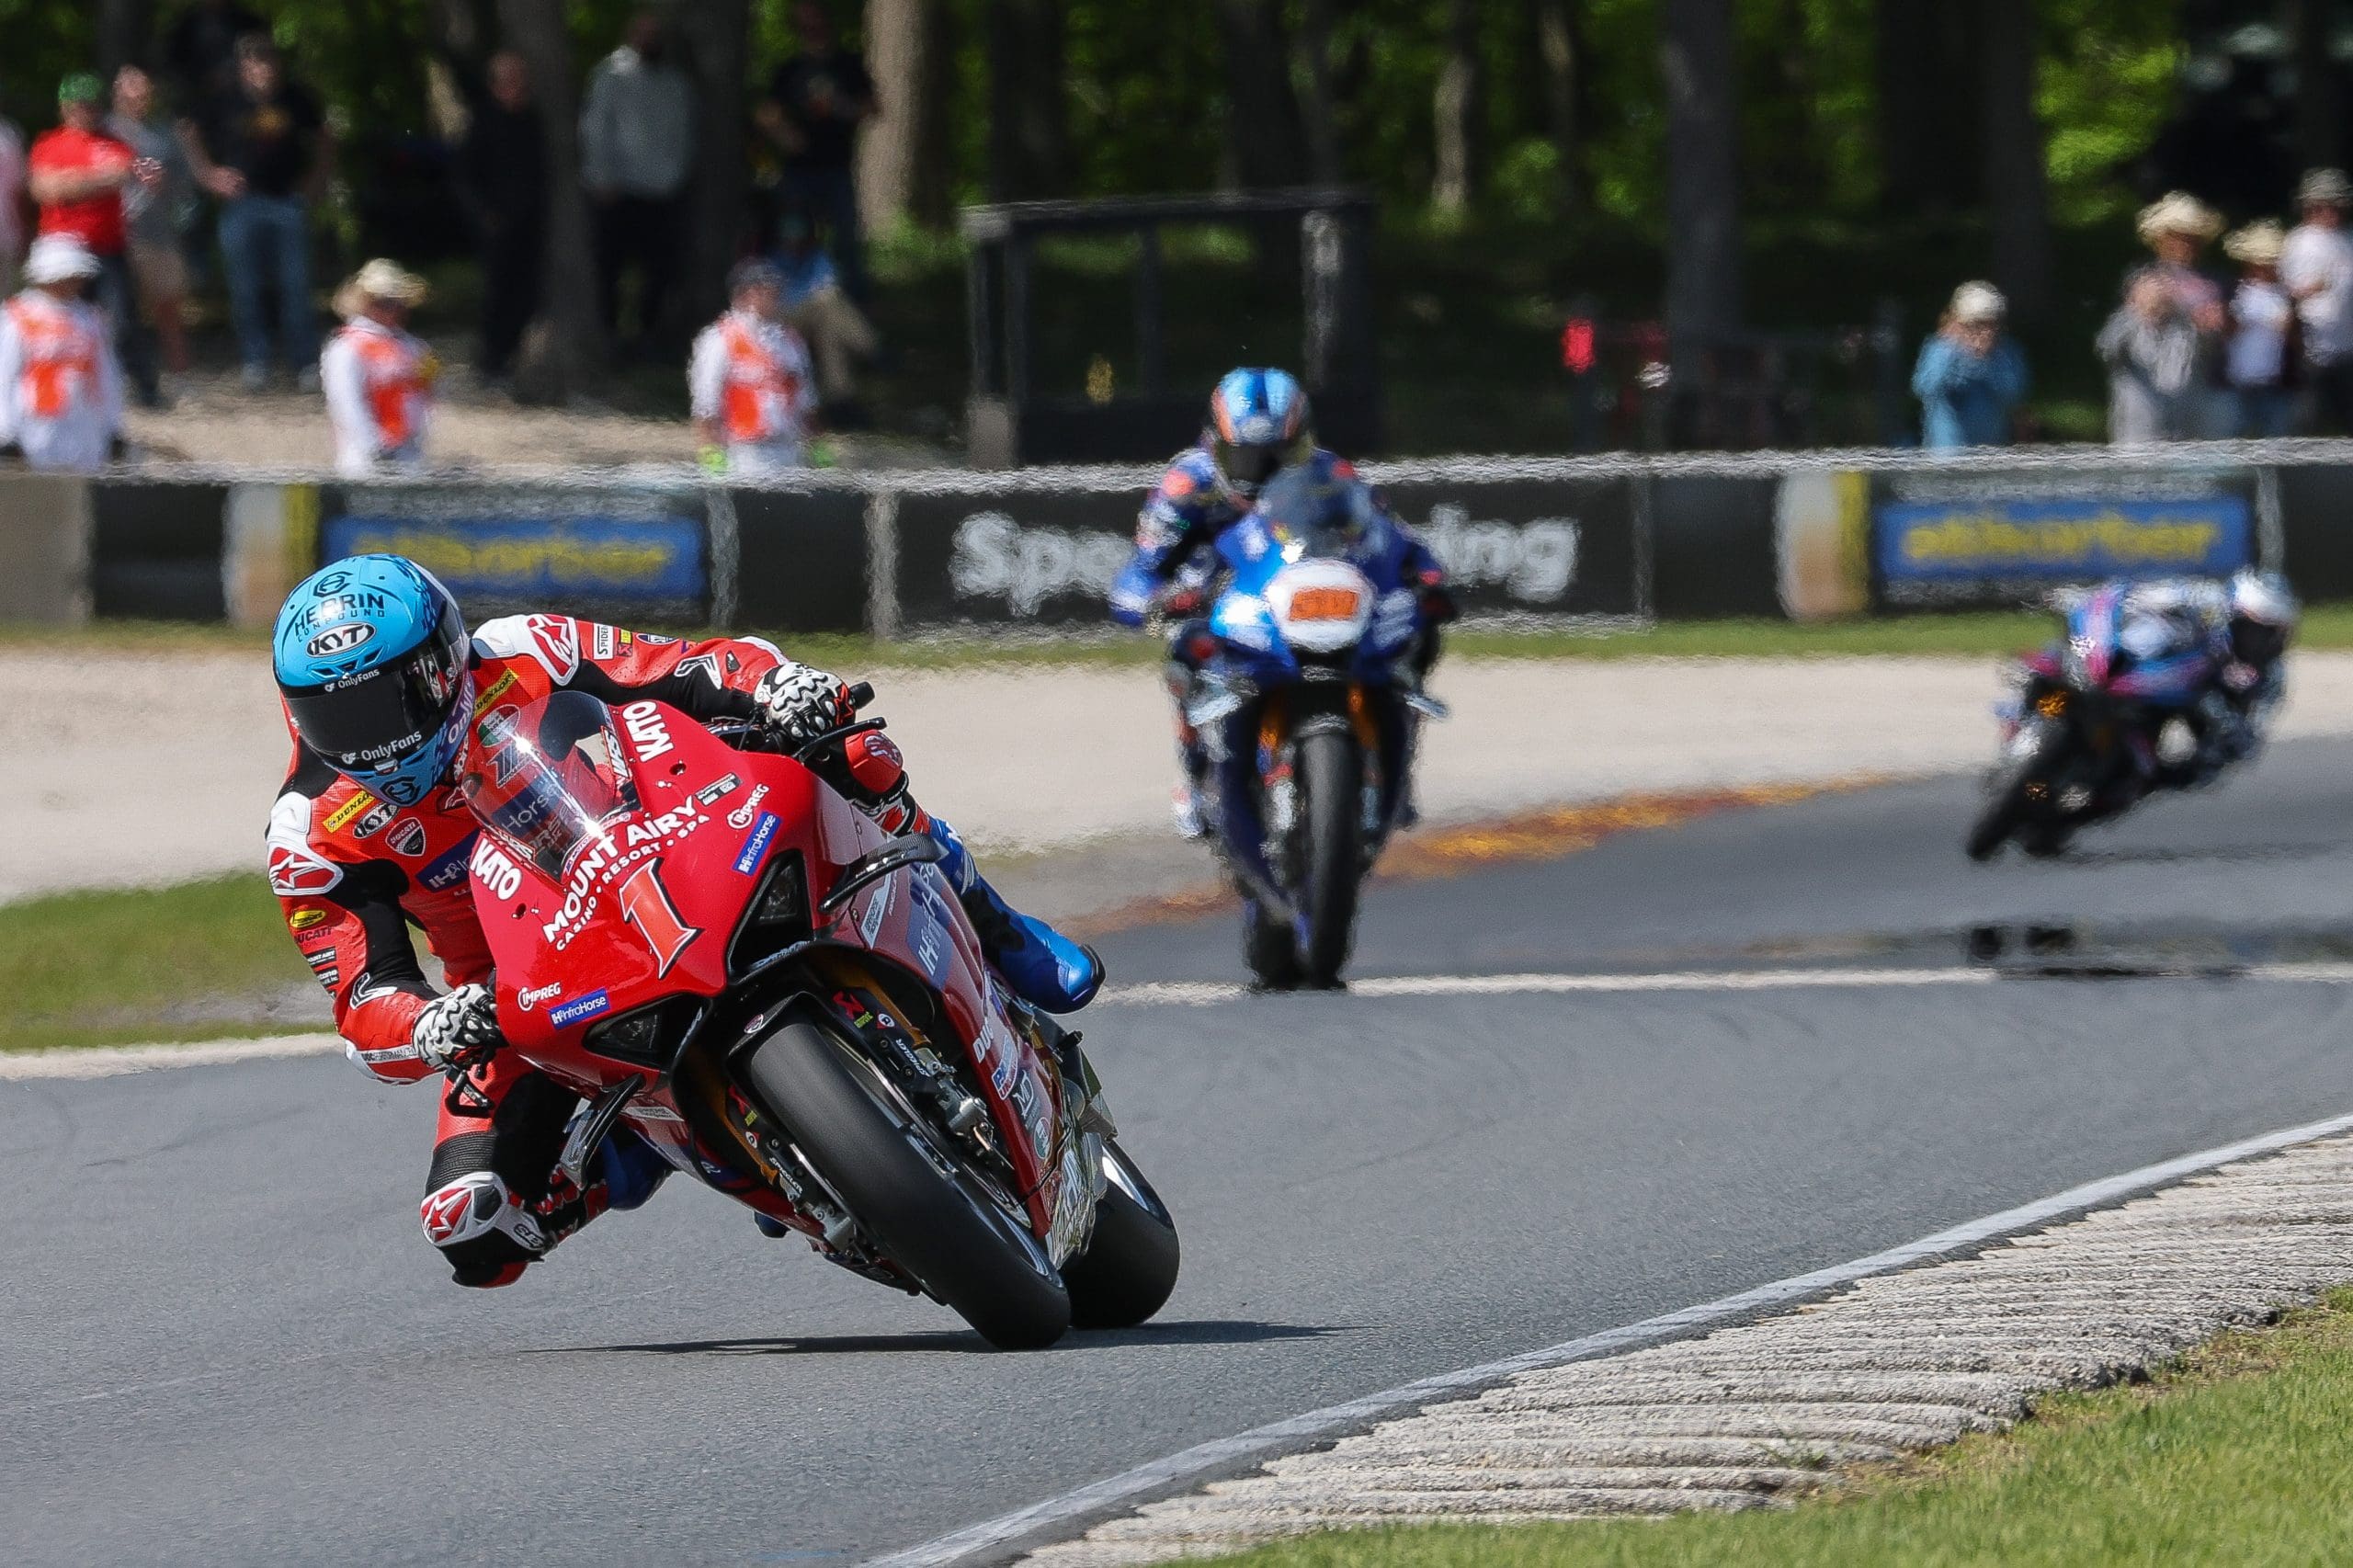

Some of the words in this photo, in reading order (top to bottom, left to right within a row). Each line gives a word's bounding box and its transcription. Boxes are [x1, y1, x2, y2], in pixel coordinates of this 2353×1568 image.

[312, 624, 367, 655] KYT
[337, 668, 380, 689] OnlyFans
[361, 731, 422, 761] OnlyFans
[622, 700, 674, 762] KATO
[336, 792, 371, 822] DUNLO
[471, 839, 522, 900] KATO
[543, 834, 617, 944] MOUNT
[626, 796, 698, 847] AIRY
[556, 896, 597, 951] CASINO
[601, 841, 661, 884] RESORT
[678, 814, 710, 839] SPA
[619, 858, 698, 980] 1
